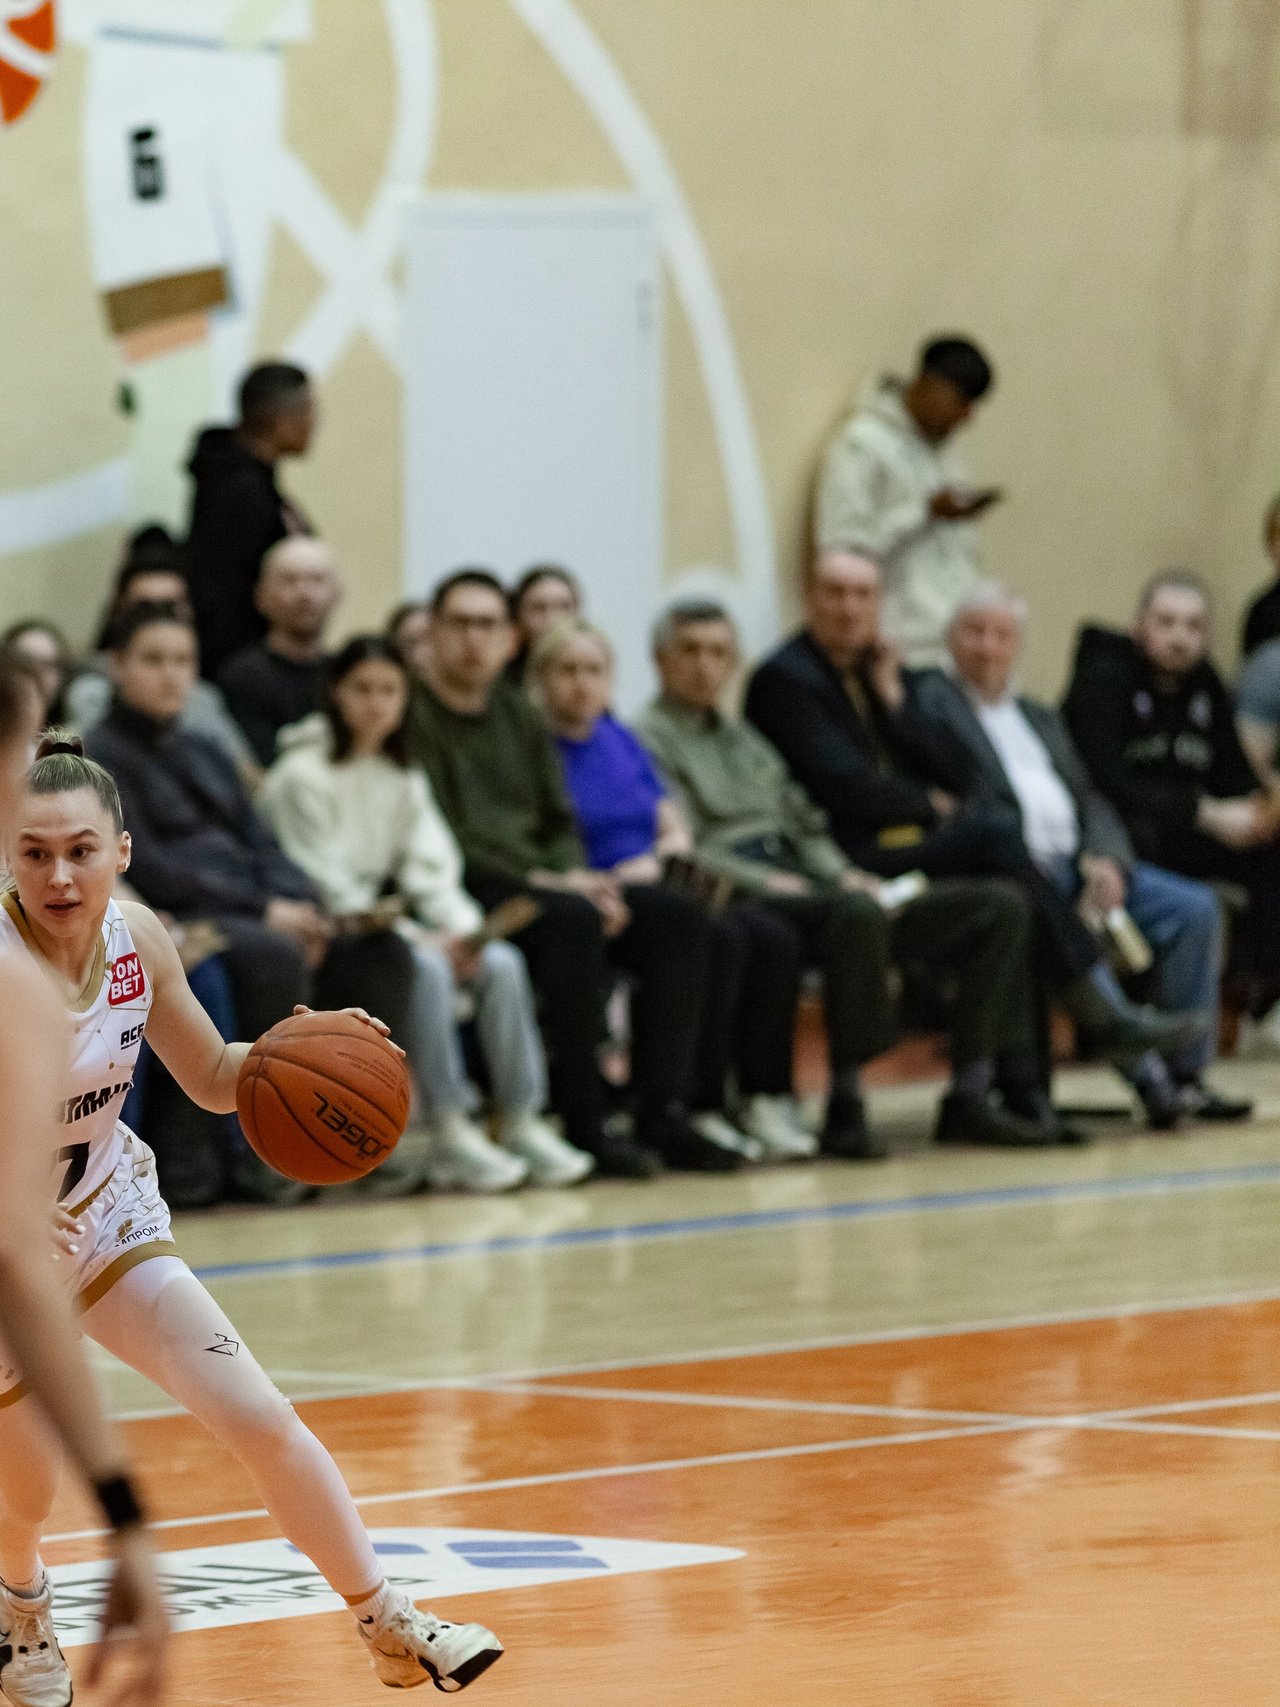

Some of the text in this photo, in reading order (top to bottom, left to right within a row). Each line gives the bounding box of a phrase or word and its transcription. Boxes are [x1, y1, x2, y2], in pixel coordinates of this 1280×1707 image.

[113, 957, 139, 979] ON
[111, 974, 141, 1000] BET
[313, 1089, 390, 1161] JÖGEL
